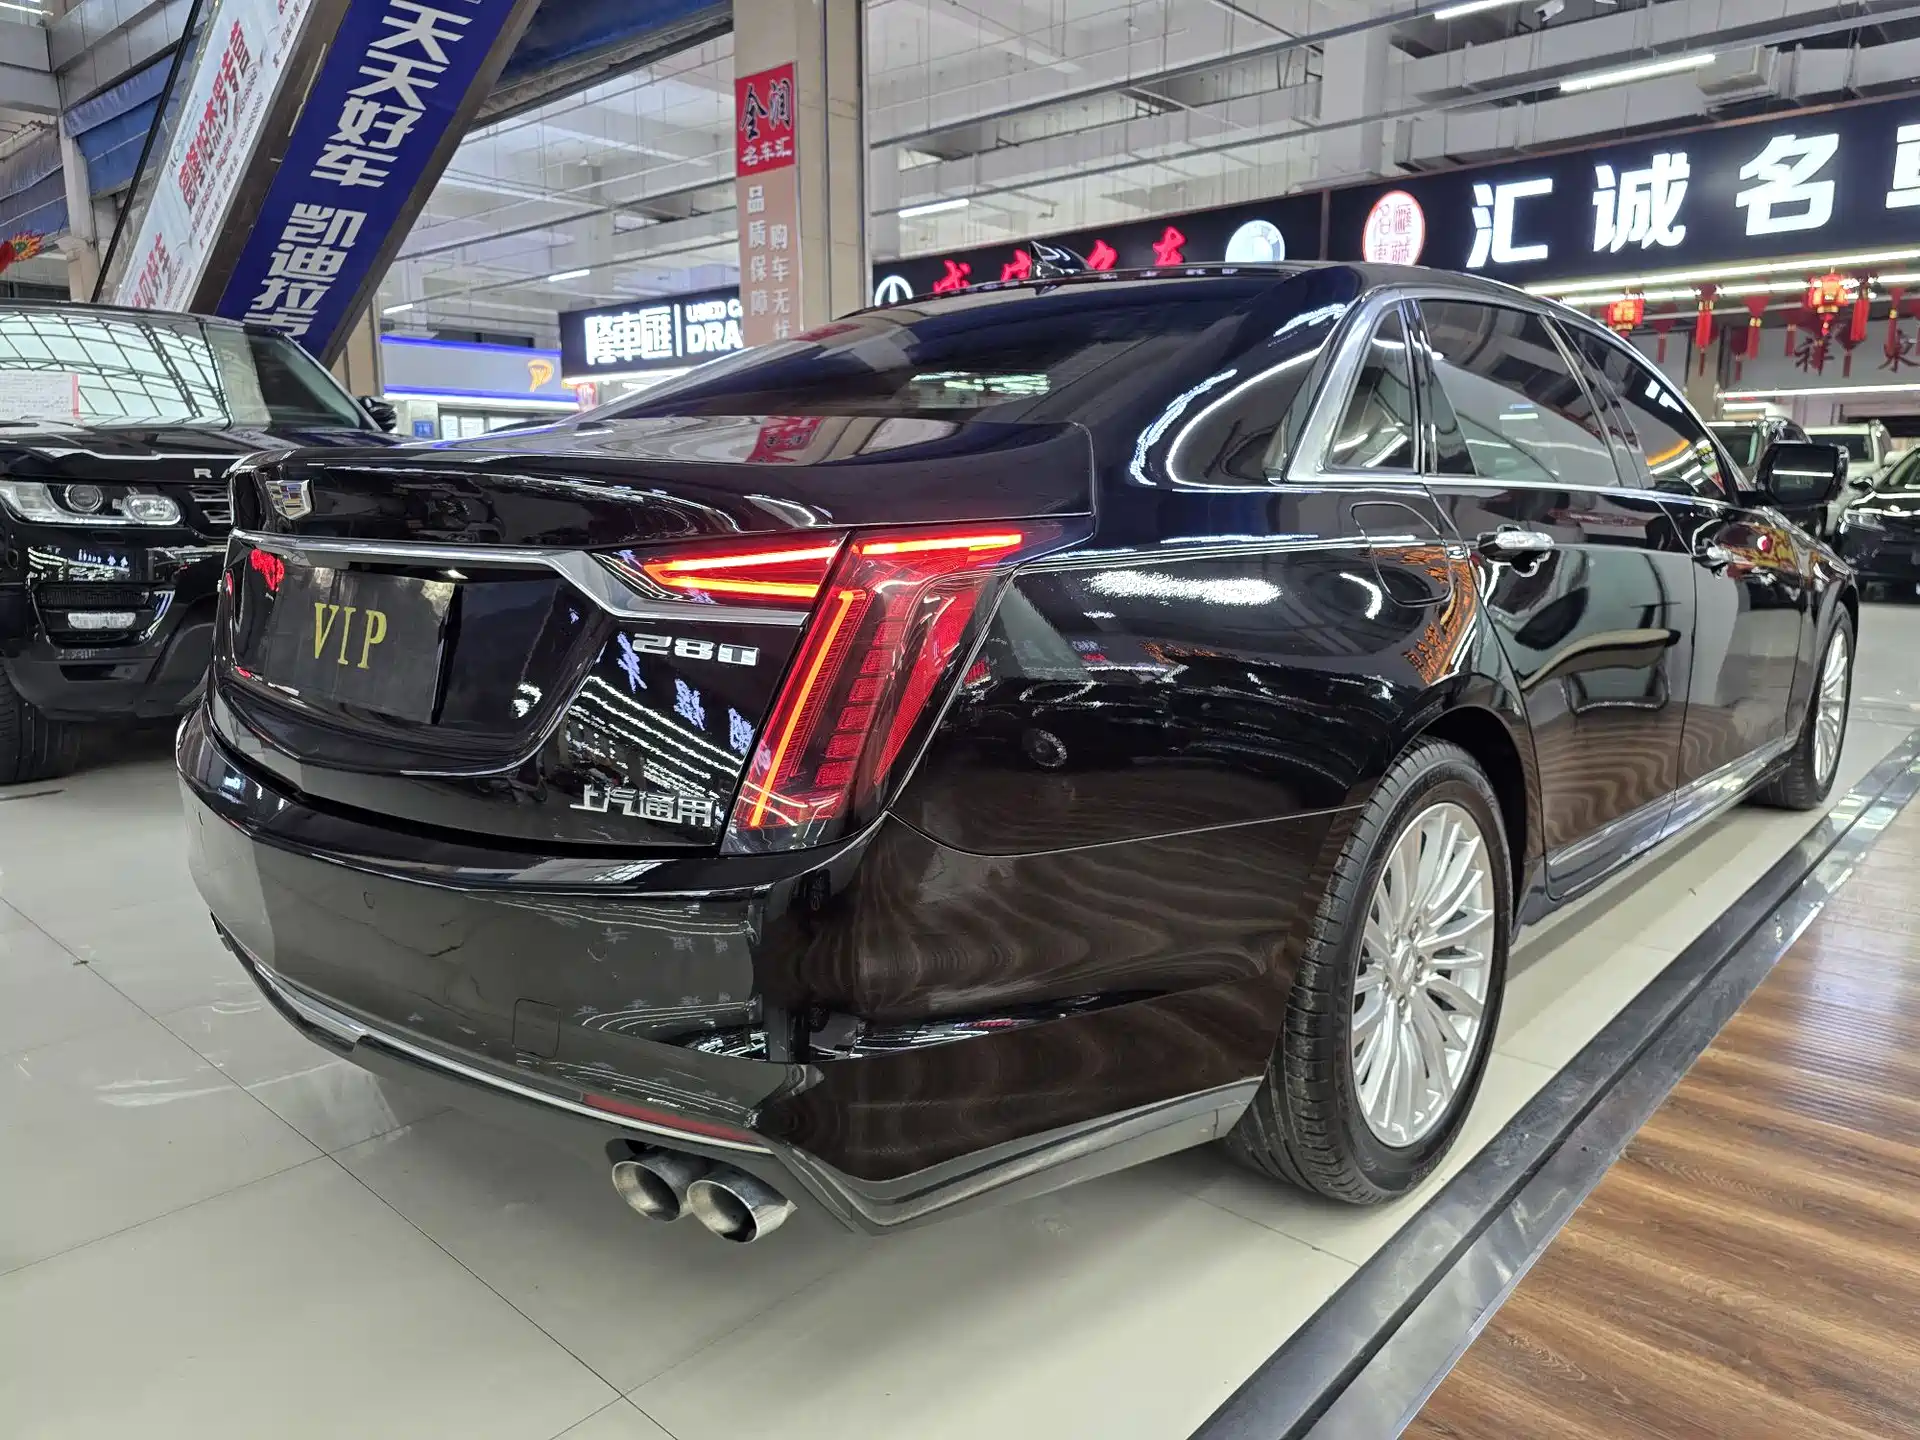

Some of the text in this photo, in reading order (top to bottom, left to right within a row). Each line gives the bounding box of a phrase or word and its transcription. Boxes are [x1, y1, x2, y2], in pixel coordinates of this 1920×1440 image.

[741, 136, 792, 166] 名车汇
[314, 602, 387, 670] VIP
[569, 783, 714, 828] 上汽通用
